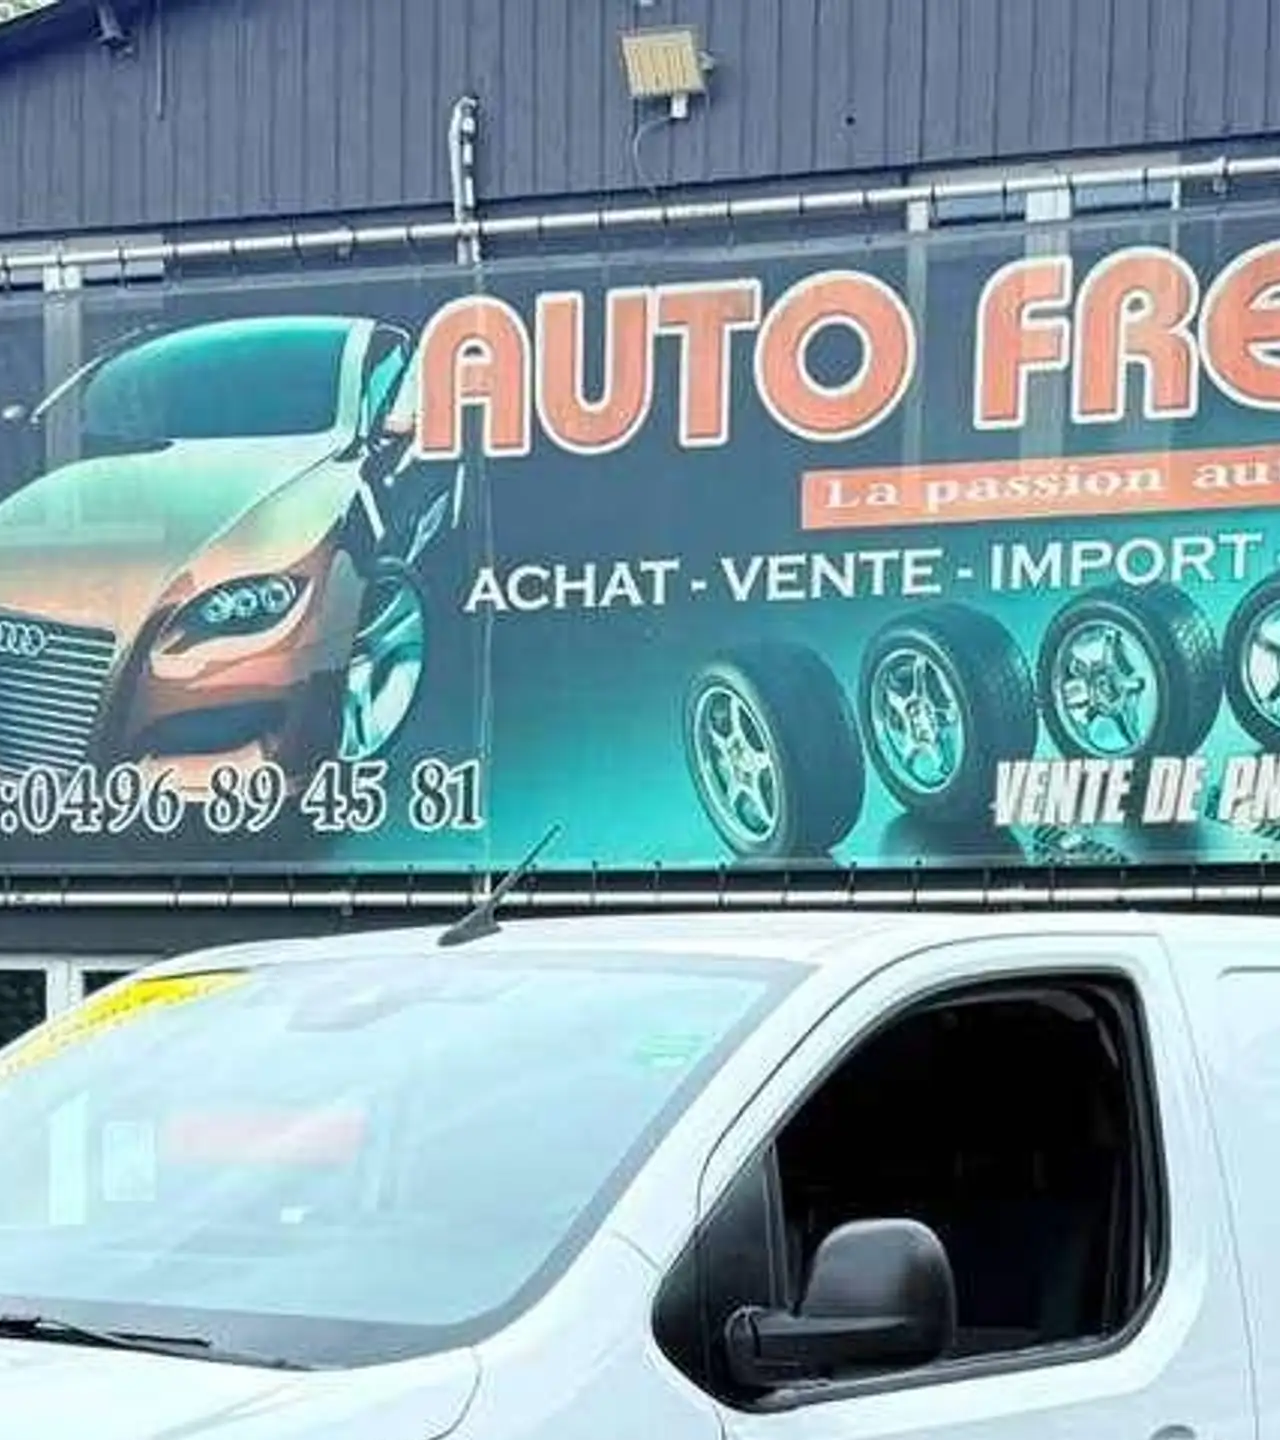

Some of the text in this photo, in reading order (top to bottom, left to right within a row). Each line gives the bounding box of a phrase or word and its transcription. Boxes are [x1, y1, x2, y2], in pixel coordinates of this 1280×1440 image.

[414, 270, 917, 460] AUTO
[824, 474, 898, 510] La
[925, 464, 1164, 514] passion
[465, 561, 679, 613] ACHAT
[721, 548, 943, 602] VENTE
[991, 533, 1263, 590] IMPORT
[203, 762, 286, 834] 89
[300, 759, 389, 832] 45
[408, 757, 485, 831] 81
[992, 757, 1135, 826] VENTE
[1142, 756, 1207, 825] DE
